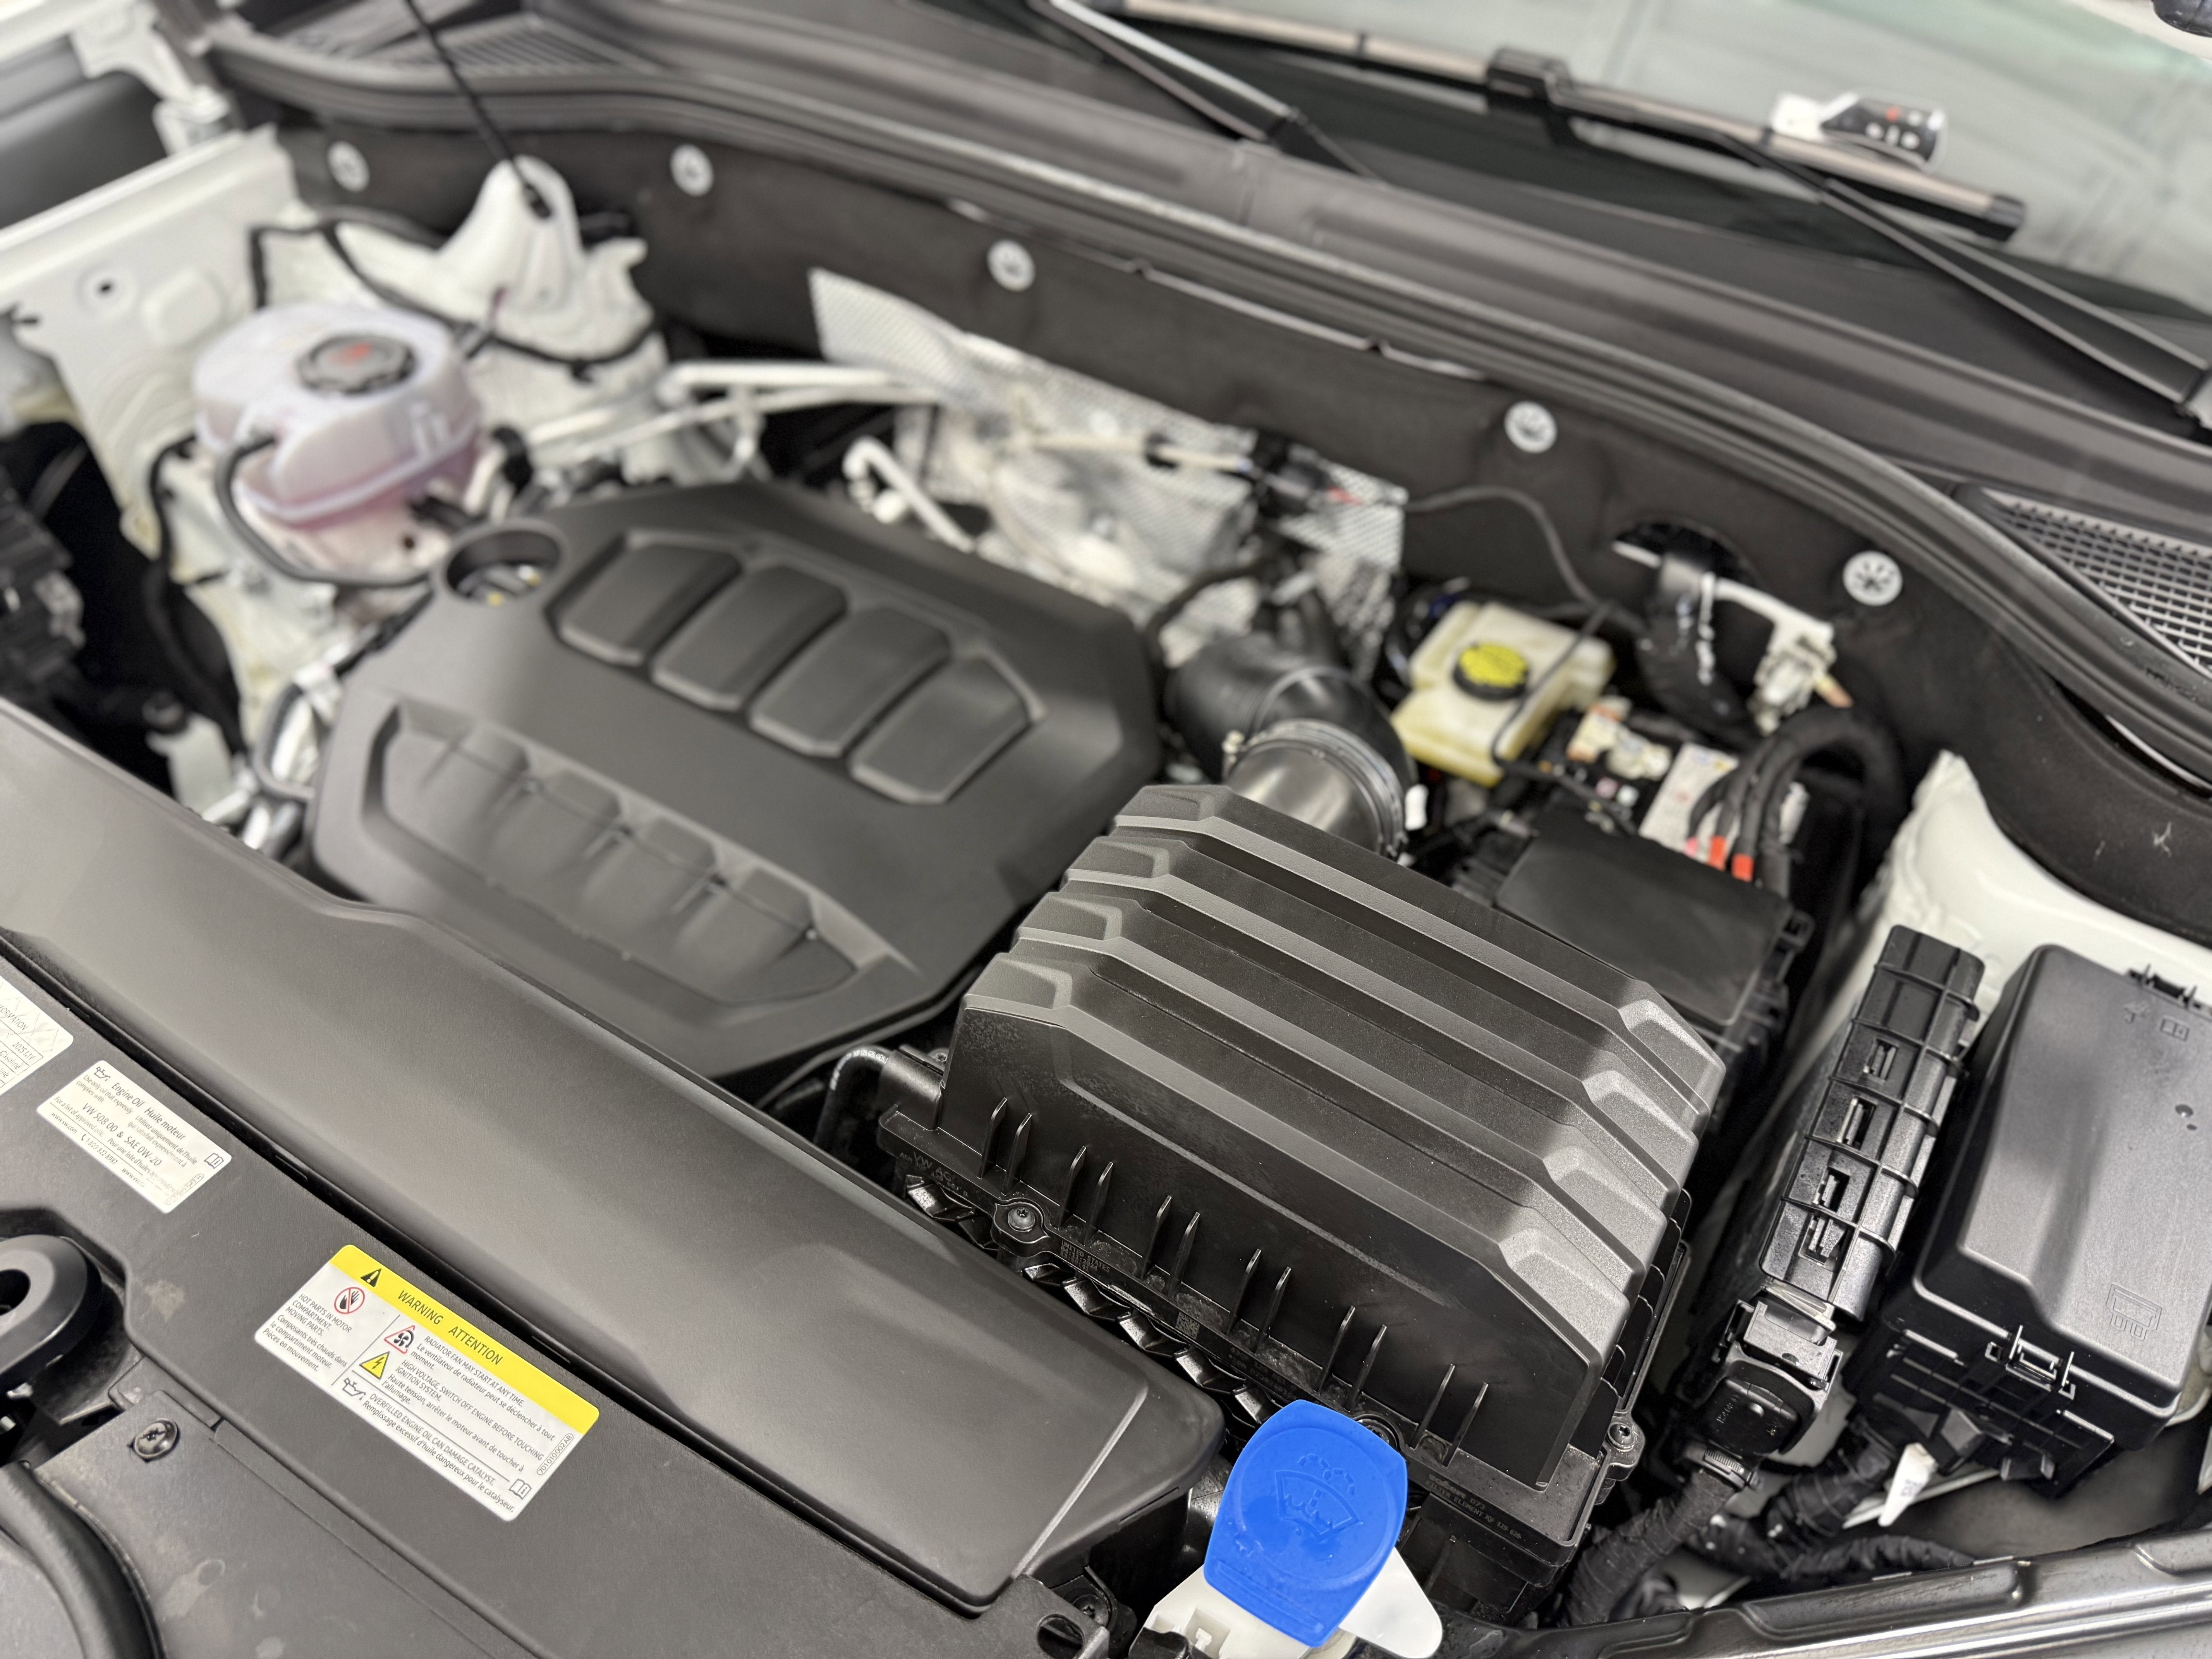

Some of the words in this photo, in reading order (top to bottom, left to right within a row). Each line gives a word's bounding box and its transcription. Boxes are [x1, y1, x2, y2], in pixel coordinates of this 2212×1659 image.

[12, 1041, 27, 1053] 2025
[76, 1081, 94, 1095] complies
[93, 1094, 104, 1103] with
[83, 1075, 92, 1083] Use
[91, 1081, 100, 1090] only
[105, 1091, 115, 1100] that
[113, 1099, 133, 1114] expressly
[111, 1082, 133, 1100] Engine
[132, 1098, 145, 1107] Oil
[144, 1107, 162, 1123] Huile
[161, 1121, 185, 1140] moteur
[64, 1104, 73, 1112] list
[75, 1114, 97, 1130] approved
[82, 1103, 97, 1115] VW
[93, 1112, 109, 1125] 508
[106, 1122, 118, 1132] 00
[124, 1136, 140, 1149] SAE
[137, 1146, 161, 1166] 0W-20
[135, 1115, 152, 1130] Utilisez
[150, 1128, 178, 1149] uniquement
[135, 1127, 154, 1141] satisfait
[107, 1137, 118, 1147] Pour
[117, 1146, 127, 1154] une
[125, 1151, 135, 1161] liste
[914, 1151, 932, 1168] VW
[935, 1167, 951, 1181] AG
[1061, 1240, 1084, 1257] UNITED
[1087, 1255, 1110, 1272] STATES
[285, 1306, 308, 1324] MOVING
[306, 1321, 324, 1336] PARTS.
[292, 1300, 331, 1330] COMPARTMENT.
[298, 1293, 312, 1304] HOT
[309, 1301, 327, 1315] PARTS
[331, 1317, 352, 1333] MOTOR
[398, 1290, 443, 1324] WARNING
[448, 1326, 503, 1365] ATTENTION
[263, 1328, 280, 1343] Pièces
[286, 1346, 318, 1371] mouvement.
[275, 1326, 313, 1354] compartiment
[311, 1352, 331, 1368] moteur.
[277, 1314, 308, 1339] Composants
[307, 1336, 318, 1346] très
[316, 1344, 335, 1358] chauds
[334, 1356, 347, 1367] dans
[410, 1351, 434, 1370] moment.
[424, 1336, 452, 1357] RADIATOR
[450, 1353, 463, 1364] FAN
[461, 1361, 476, 1372] MAY
[473, 1369, 492, 1383] START
[496, 1386, 511, 1396] ANY
[509, 1393, 524, 1407] TIME.
[395, 1366, 421, 1386] IGNITION
[419, 1382, 441, 1401] SYSTEM.
[417, 1343, 425, 1352] Le
[424, 1349, 454, 1371] ventilateur
[460, 1374, 486, 1393] radiateur
[484, 1391, 500, 1403] peut
[506, 1405, 537, 1428] déclencher
[541, 1429, 555, 1441] tout
[388, 1374, 405, 1389] Haute
[404, 1386, 425, 1405] tension,
[426, 1401, 447, 1417] arrêter
[445, 1413, 452, 1422] le
[451, 1419, 473, 1436] moteur
[472, 1434, 489, 1448] avant
[488, 1445, 497, 1453] de
[496, 1450, 519, 1468] toucher
[401, 1360, 417, 1372] HIGH
[415, 1369, 440, 1390] VOLTAGE,
[439, 1386, 462, 1403] SWITCH
[460, 1400, 473, 1410] OFF
[471, 1408, 493, 1426] ENGINE
[491, 1422, 515, 1441] BEFORE
[514, 1437, 544, 1460] TOUCHING
[362, 1400, 396, 1427] Remplissage
[395, 1425, 419, 1442] excessif
[436, 1453, 465, 1477] dangereux
[463, 1474, 479, 1486] pour
[477, 1482, 484, 1491] le
[484, 1488, 514, 1512] catalyseur.
[370, 1393, 402, 1418] OVERFILLED
[401, 1415, 424, 1434] ENGINE
[422, 1431, 432, 1441] OIL
[431, 1437, 445, 1449] CAN
[443, 1446, 469, 1466] DAMAGE
[467, 1463, 495, 1486] CATALYST.
